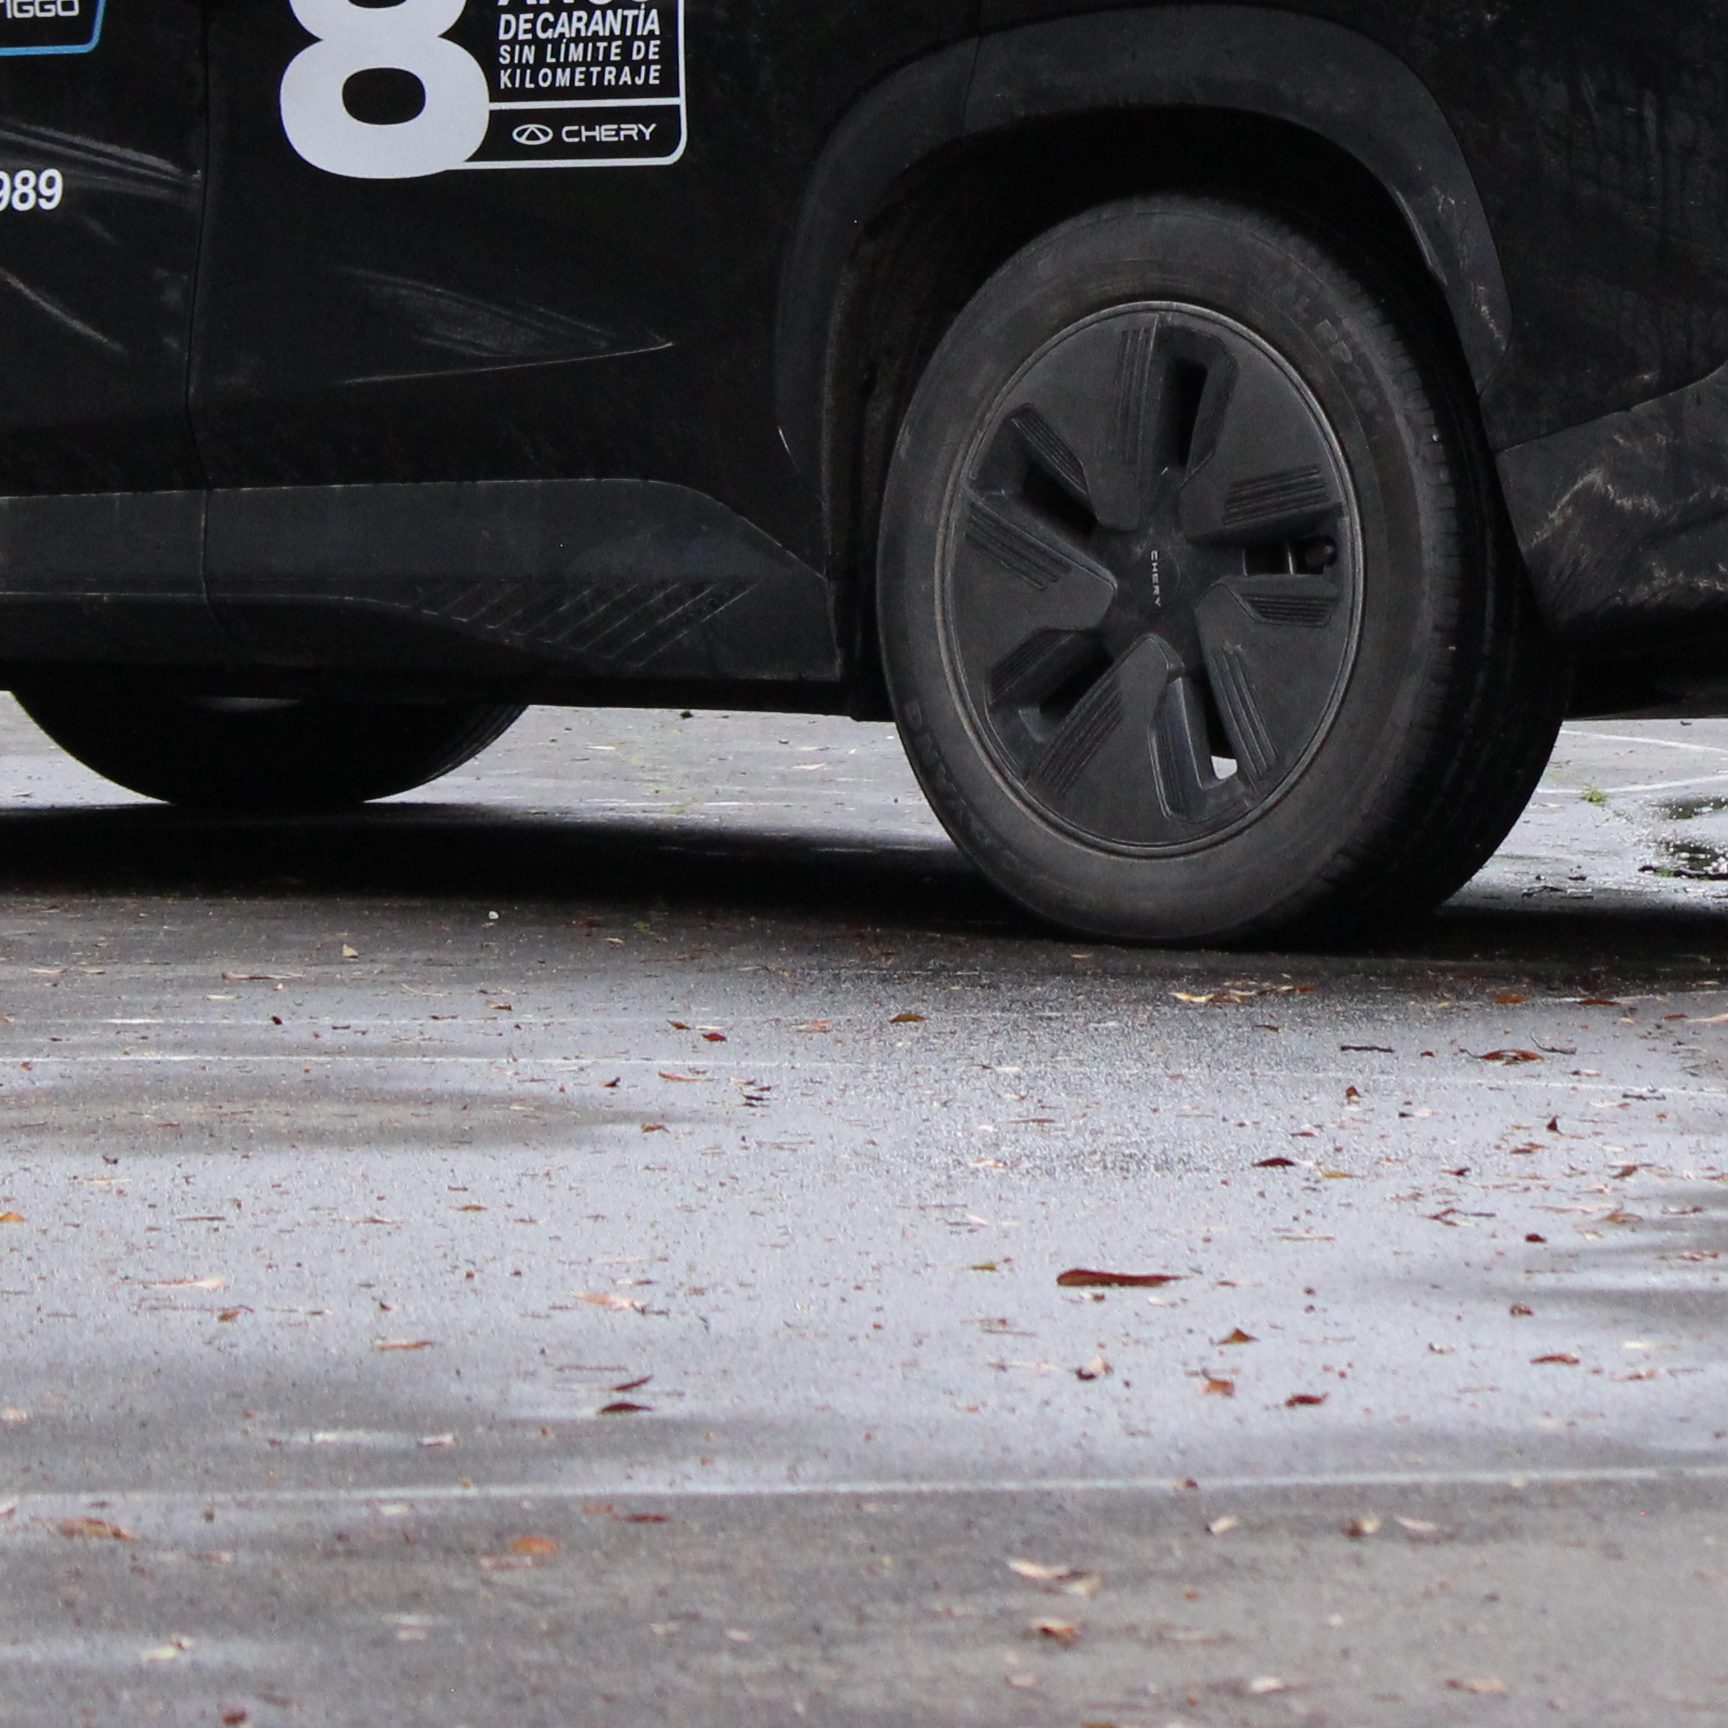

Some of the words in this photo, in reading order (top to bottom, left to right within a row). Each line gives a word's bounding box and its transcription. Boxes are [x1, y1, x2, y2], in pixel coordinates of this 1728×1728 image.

[498, 13, 534, 41] DE
[535, 3, 660, 39] GARANTÍA
[499, 44, 536, 64] SIN
[546, 38, 621, 63] LÍMITE
[632, 40, 661, 60] DE
[500, 65, 661, 89] KILOMETRAJE
[561, 123, 656, 142] CHERY
[1150, 550, 1162, 607] CHERY
